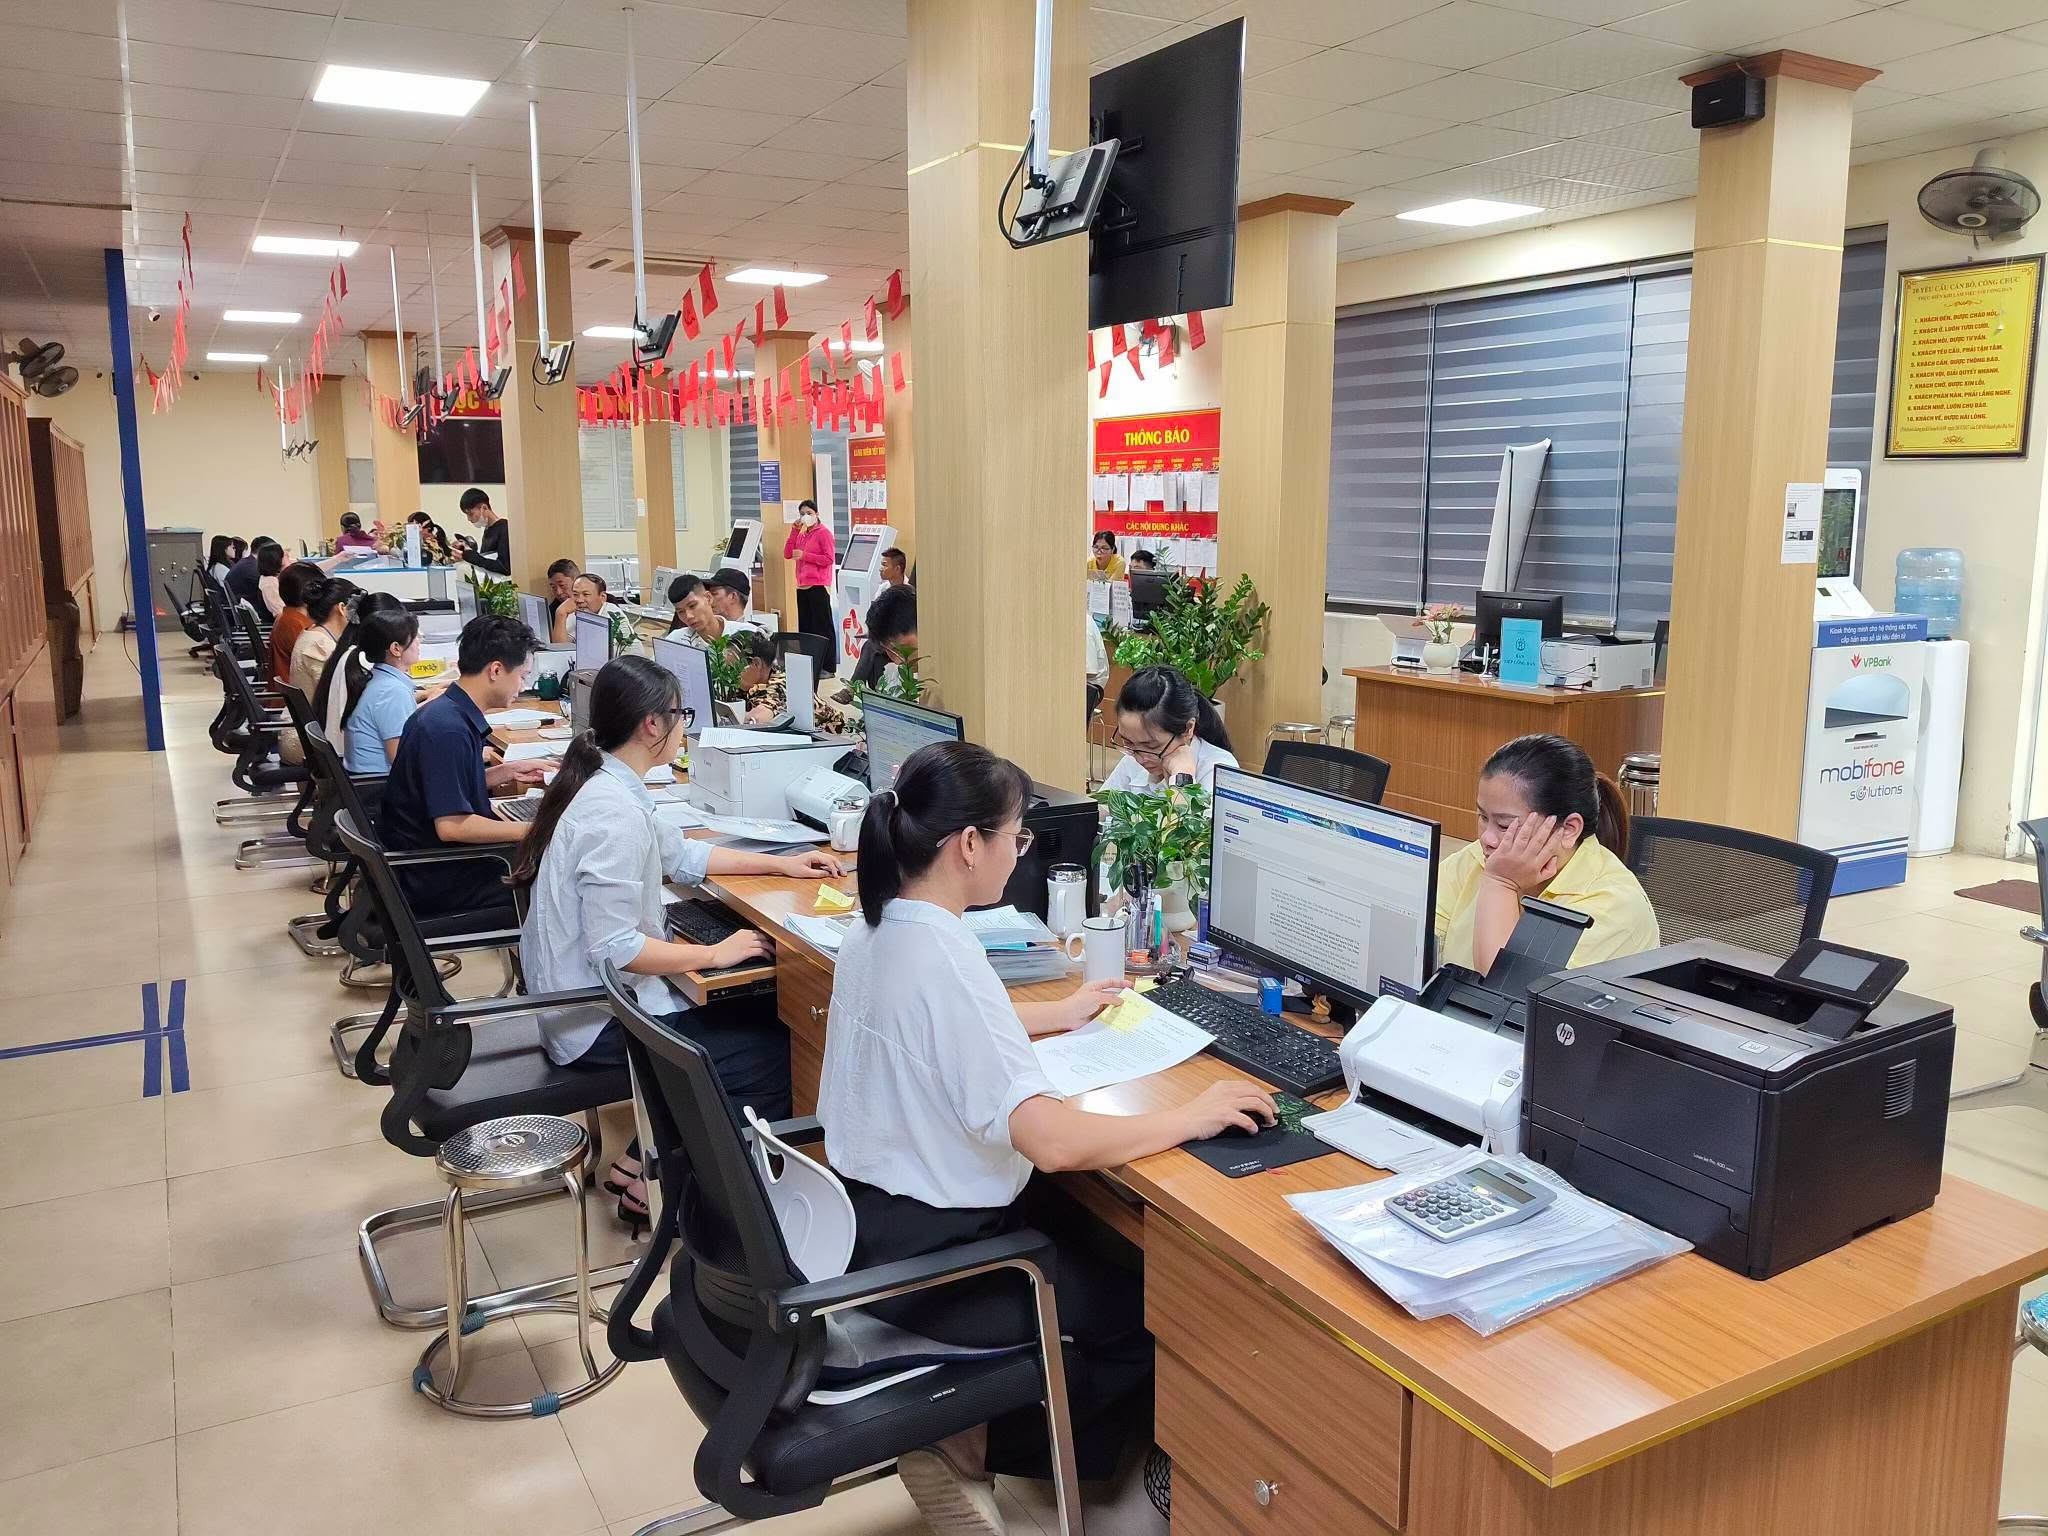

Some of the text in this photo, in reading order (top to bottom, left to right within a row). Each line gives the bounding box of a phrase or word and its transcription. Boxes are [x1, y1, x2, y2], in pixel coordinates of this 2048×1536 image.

[1124, 426, 1190, 446] THÔNG BÁO
[1126, 521, 1140, 530] CÁC
[1152, 522, 1170, 531] DUNG
[1864, 656, 1892, 668] VPBank
[1820, 758, 1904, 784] mobifone
[1850, 785, 1902, 801] solutions
[1558, 1022, 1574, 1046] hp
